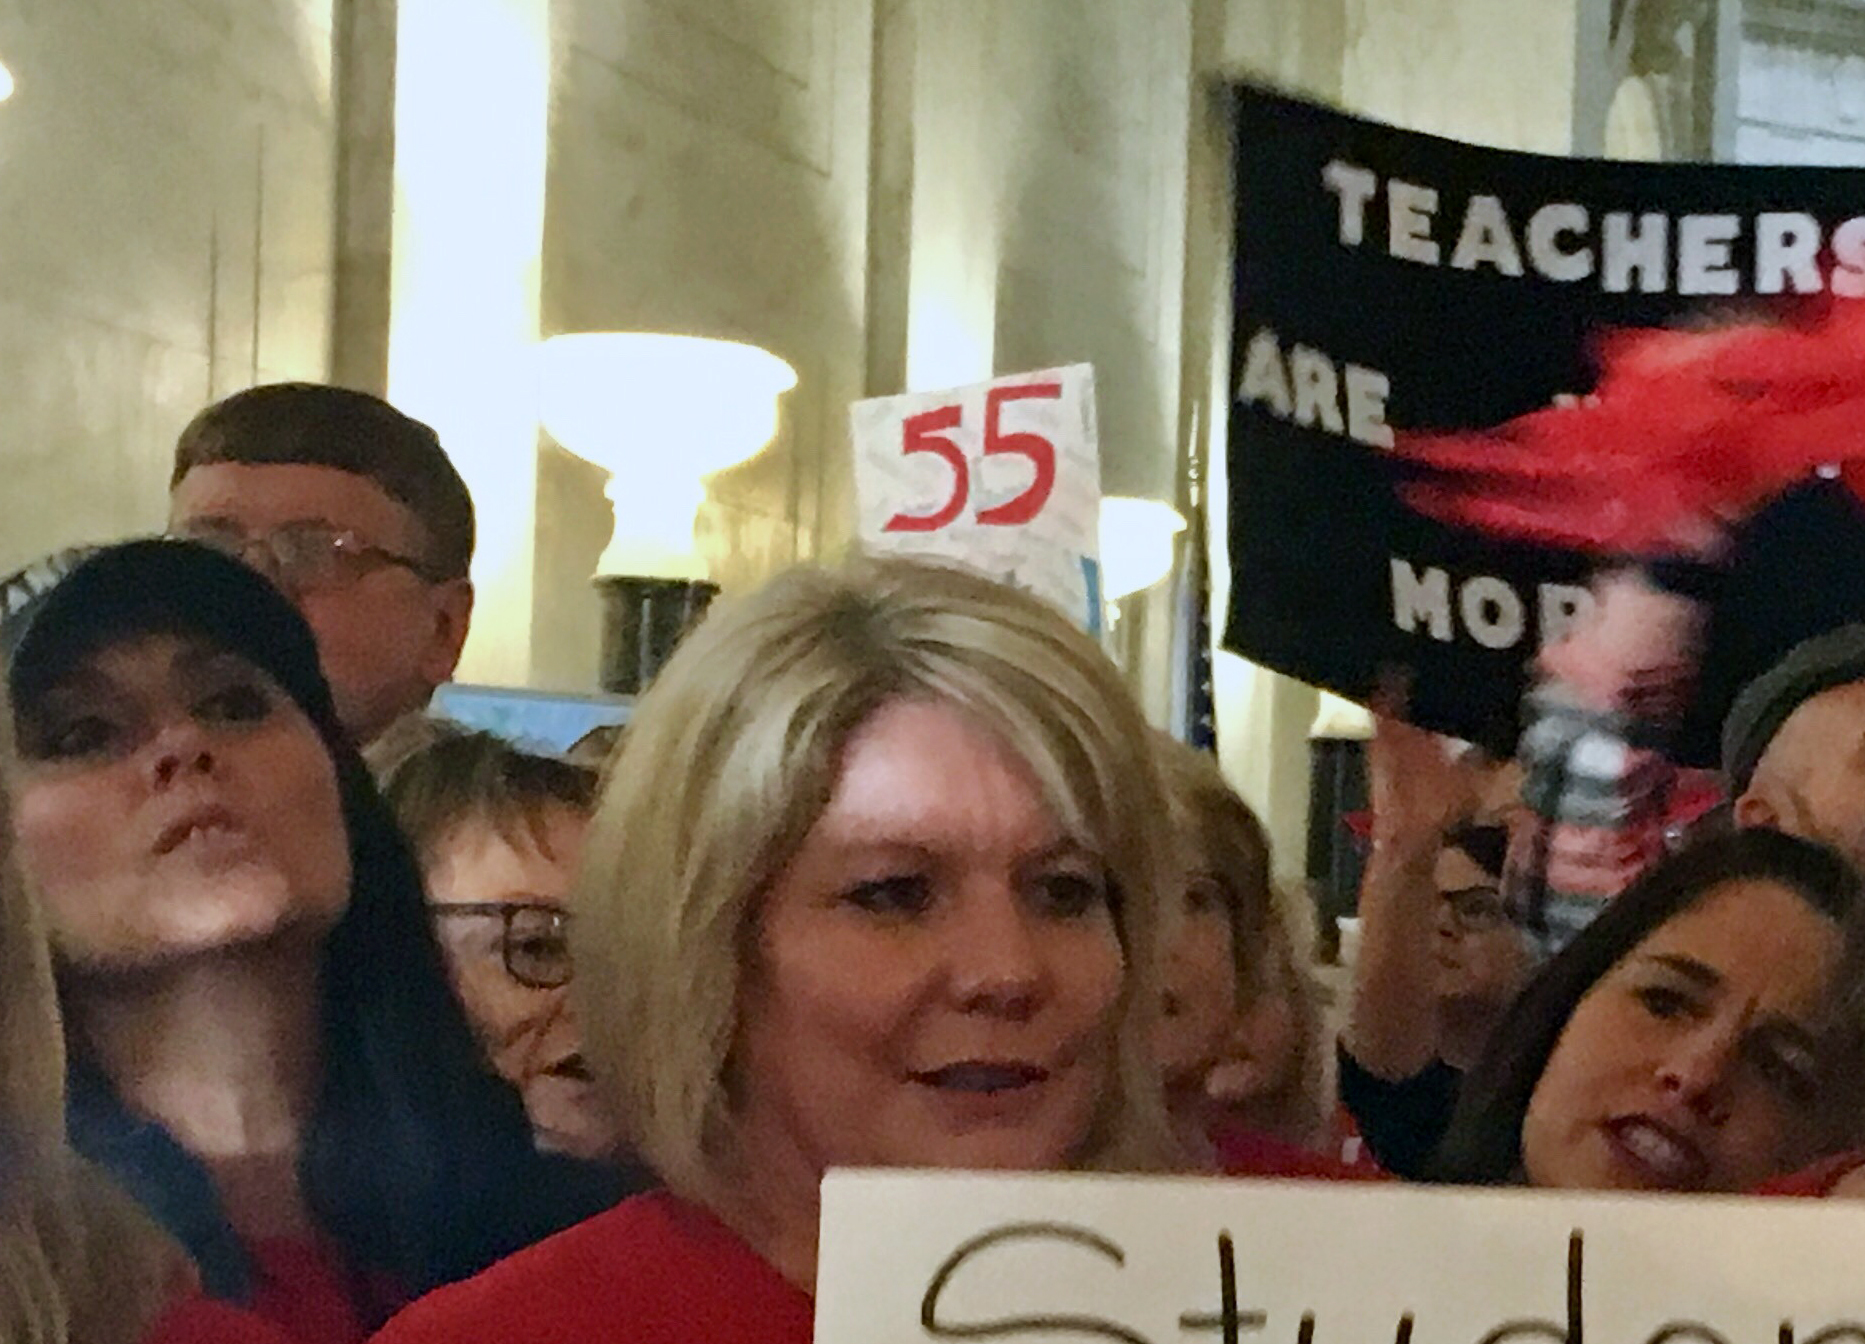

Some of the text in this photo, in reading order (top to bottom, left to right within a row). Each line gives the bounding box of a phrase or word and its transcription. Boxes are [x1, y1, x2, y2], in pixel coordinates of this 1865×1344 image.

[1238, 326, 1394, 449] ARE
[882, 383, 1062, 532] 55
[1390, 556, 1599, 649] MOR
